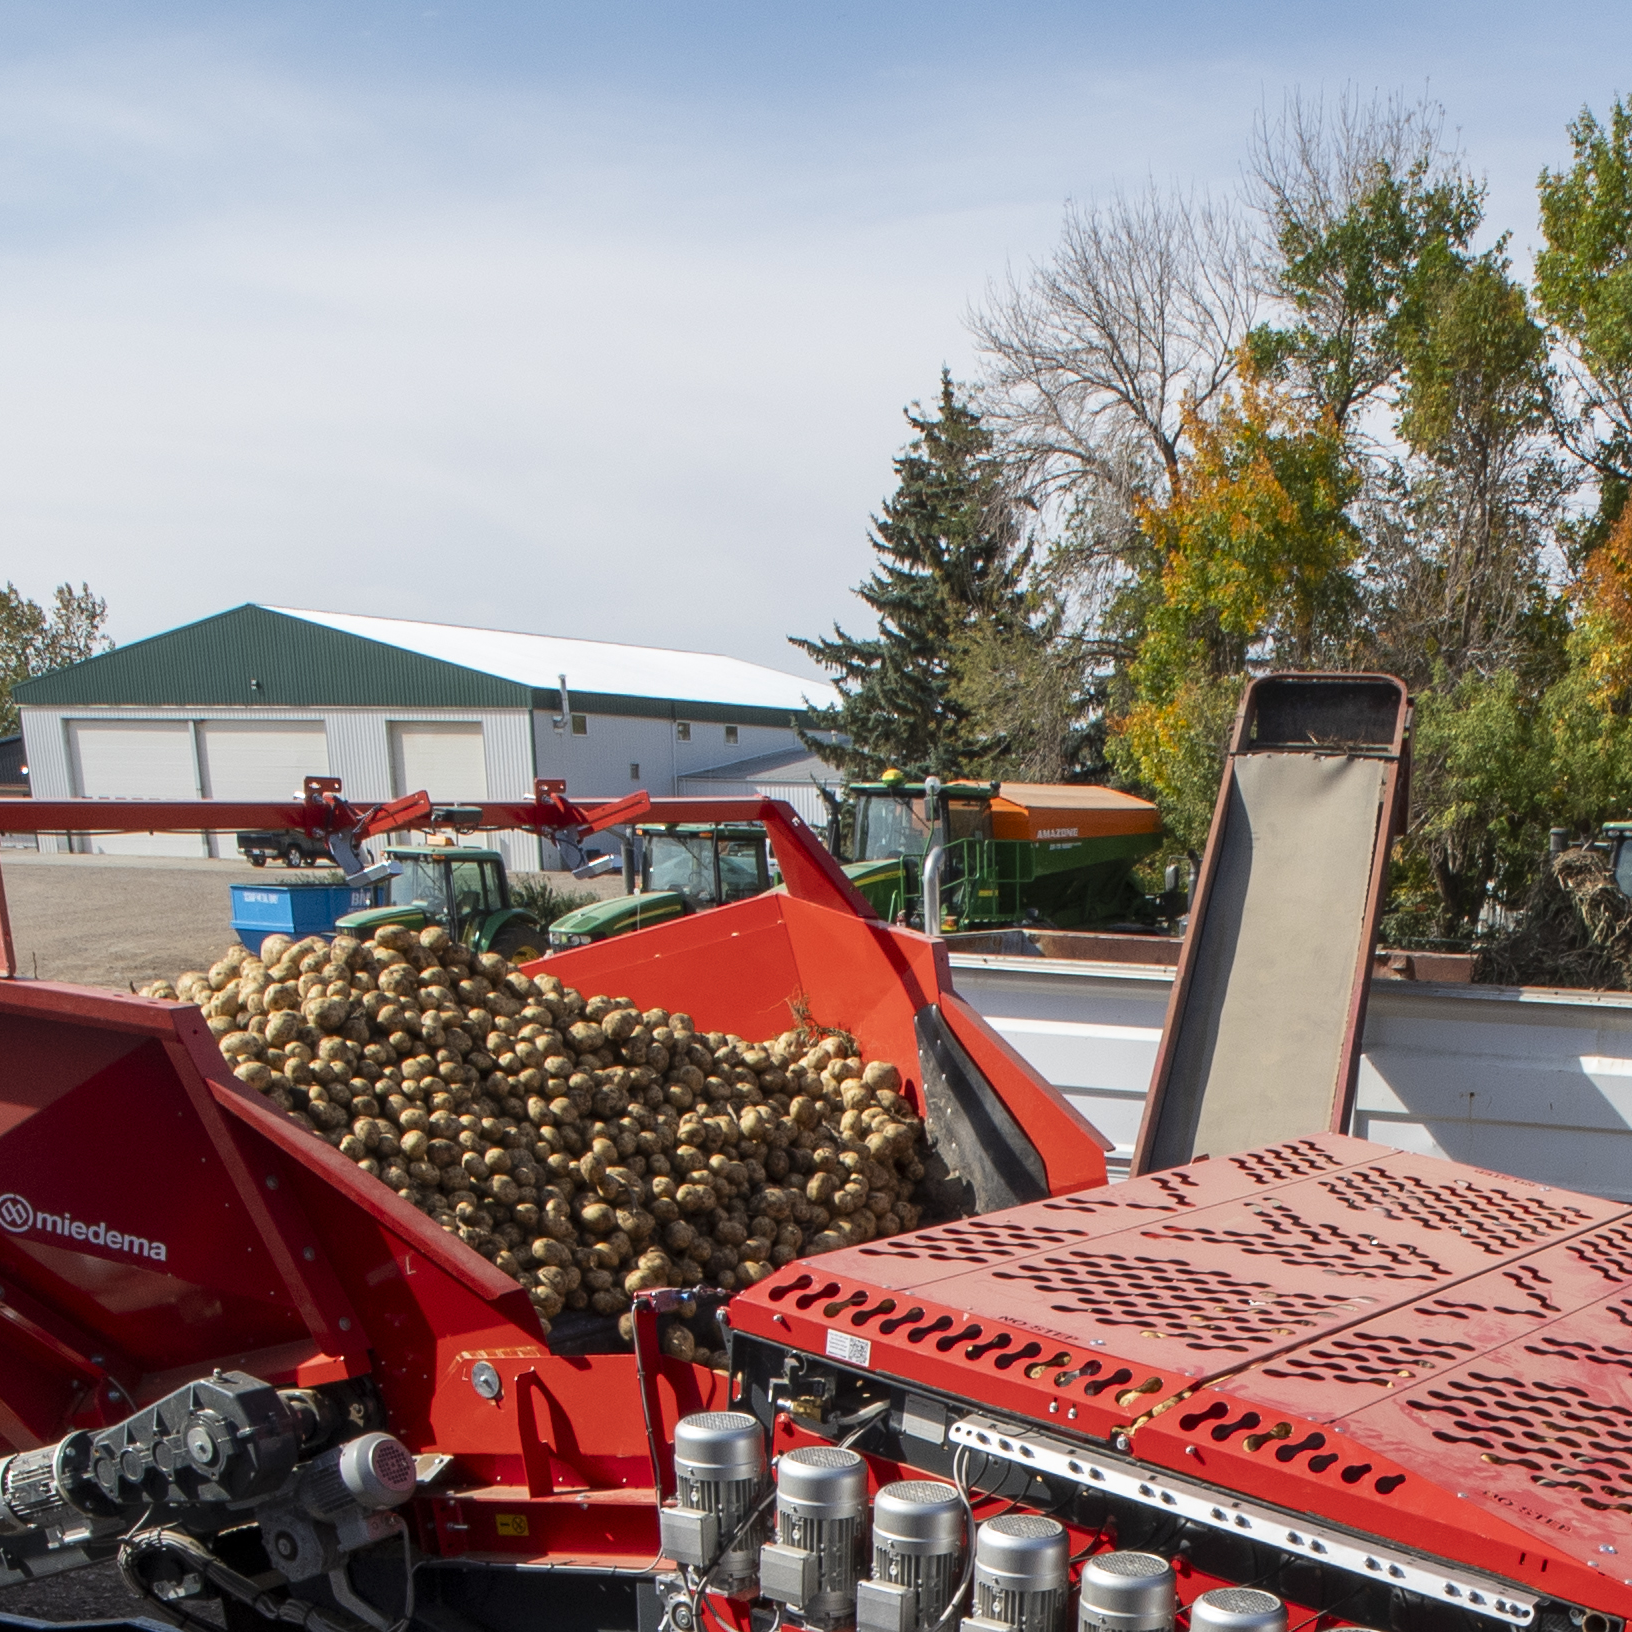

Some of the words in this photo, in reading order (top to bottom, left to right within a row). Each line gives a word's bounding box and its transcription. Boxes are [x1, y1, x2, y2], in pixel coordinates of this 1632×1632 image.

[1036, 828, 1079, 838] AMAZONE
[36, 1211, 166, 1261] miedema
[998, 1316, 1027, 1326] NO
[1030, 1325, 1079, 1341] STEP
